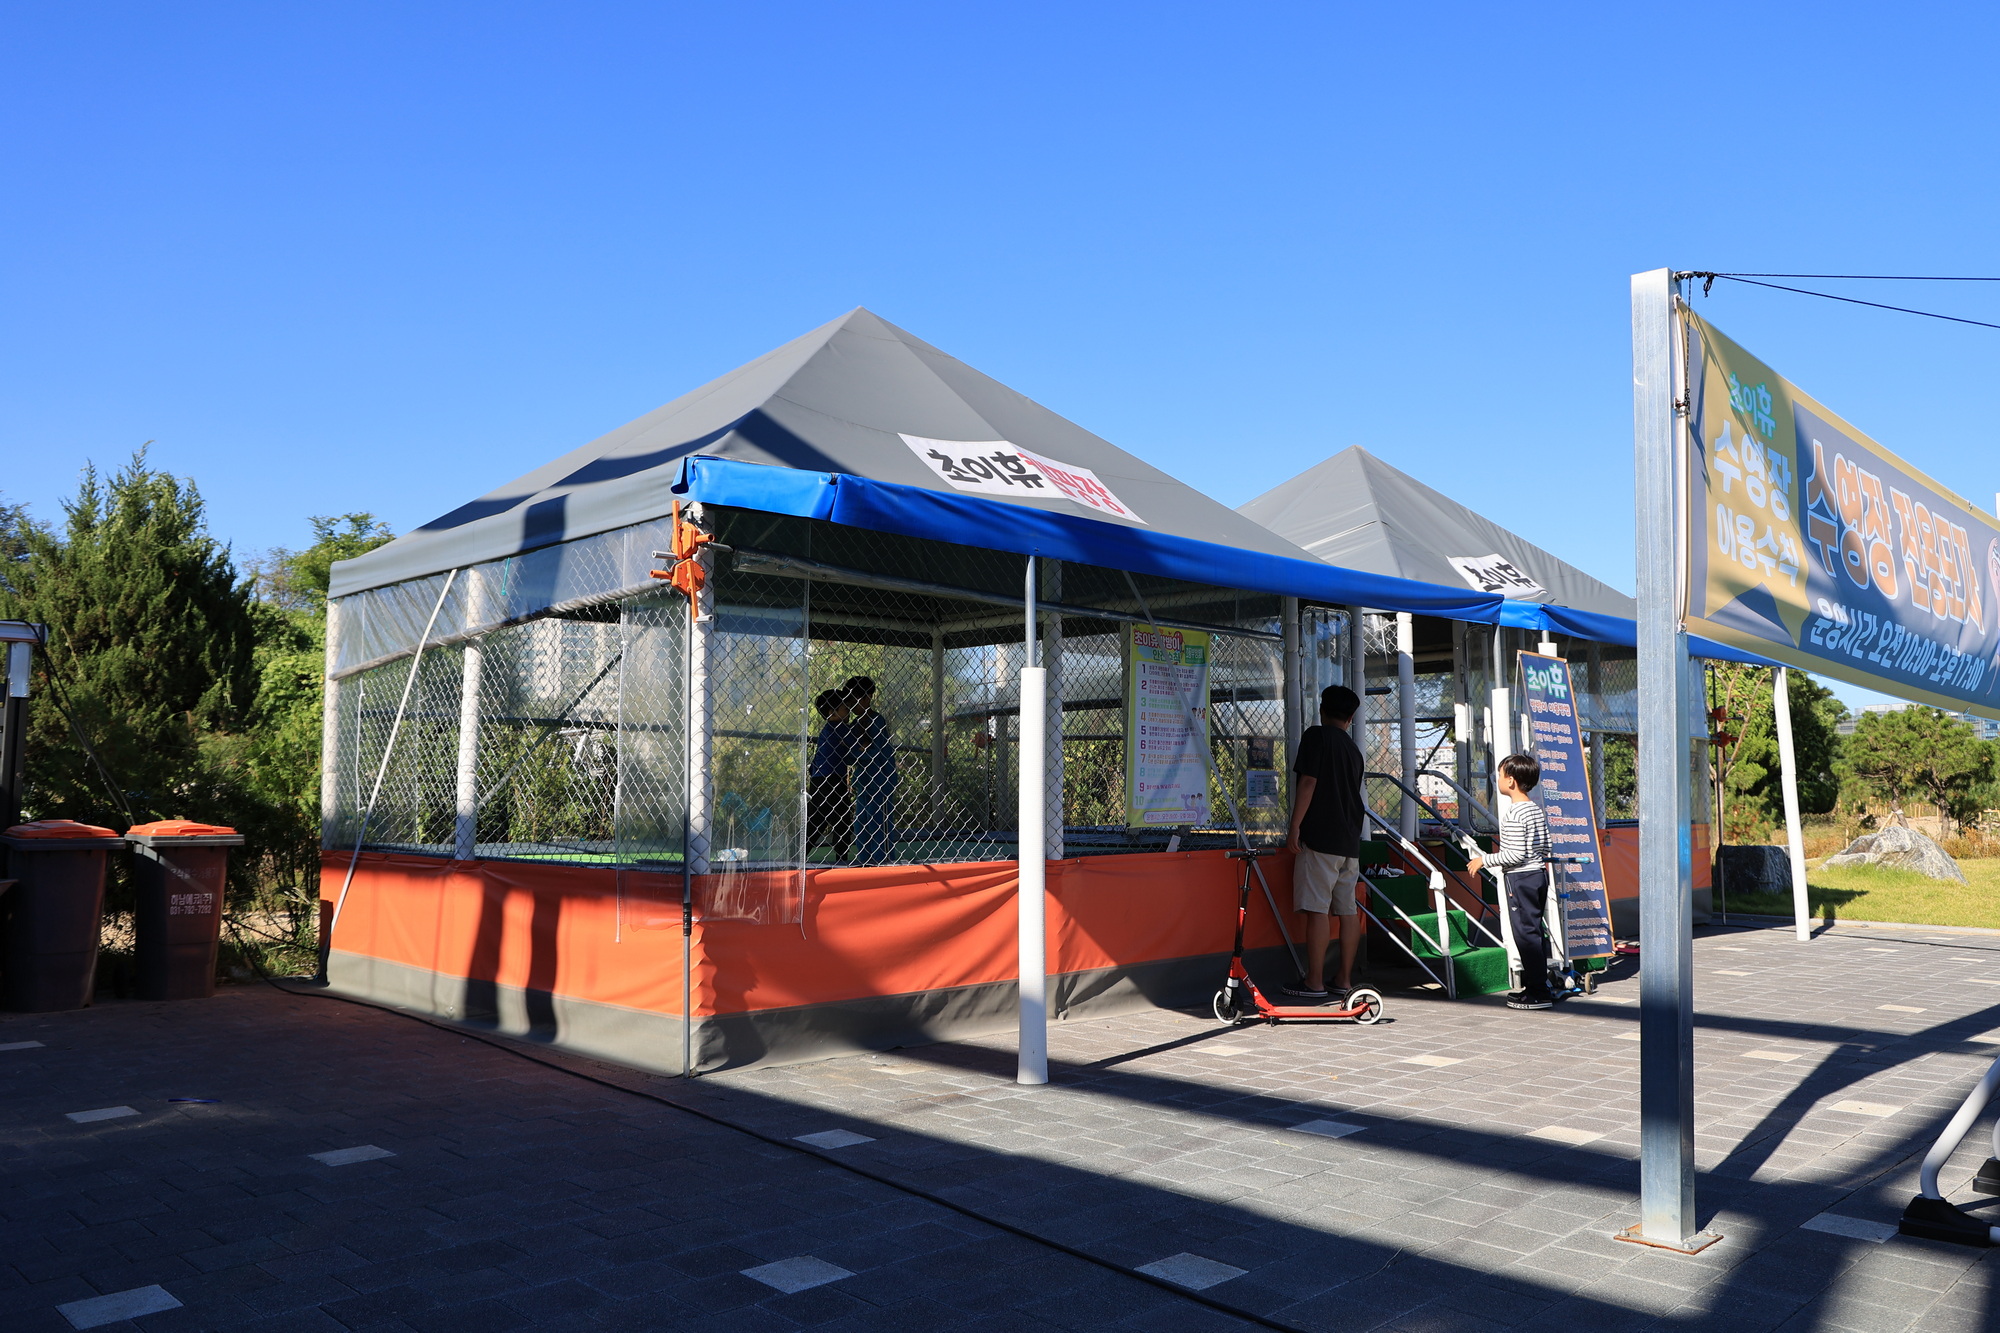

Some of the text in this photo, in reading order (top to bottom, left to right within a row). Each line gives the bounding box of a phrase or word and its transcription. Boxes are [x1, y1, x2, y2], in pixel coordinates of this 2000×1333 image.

[1729, 372, 1776, 438] 초이휴
[1713, 419, 1792, 521] 수영장
[1806, 438, 1898, 599] 수영장
[1716, 504, 1800, 587] 이용수칙
[1463, 561, 1537, 592] 초이휴
[1810, 598, 1878, 659] 운영시간
[1141, 680, 1147, 690] 2
[1526, 663, 1568, 699] 초이휴
[1141, 697, 1147, 707] 3
[1140, 712, 1146, 721] 4
[1141, 725, 1146, 735] 5
[1140, 740, 1146, 749] 6
[1140, 753, 1146, 763] 7
[1139, 767, 1145, 777] 8
[1139, 782, 1145, 792] 9
[1135, 796, 1144, 805] 10
